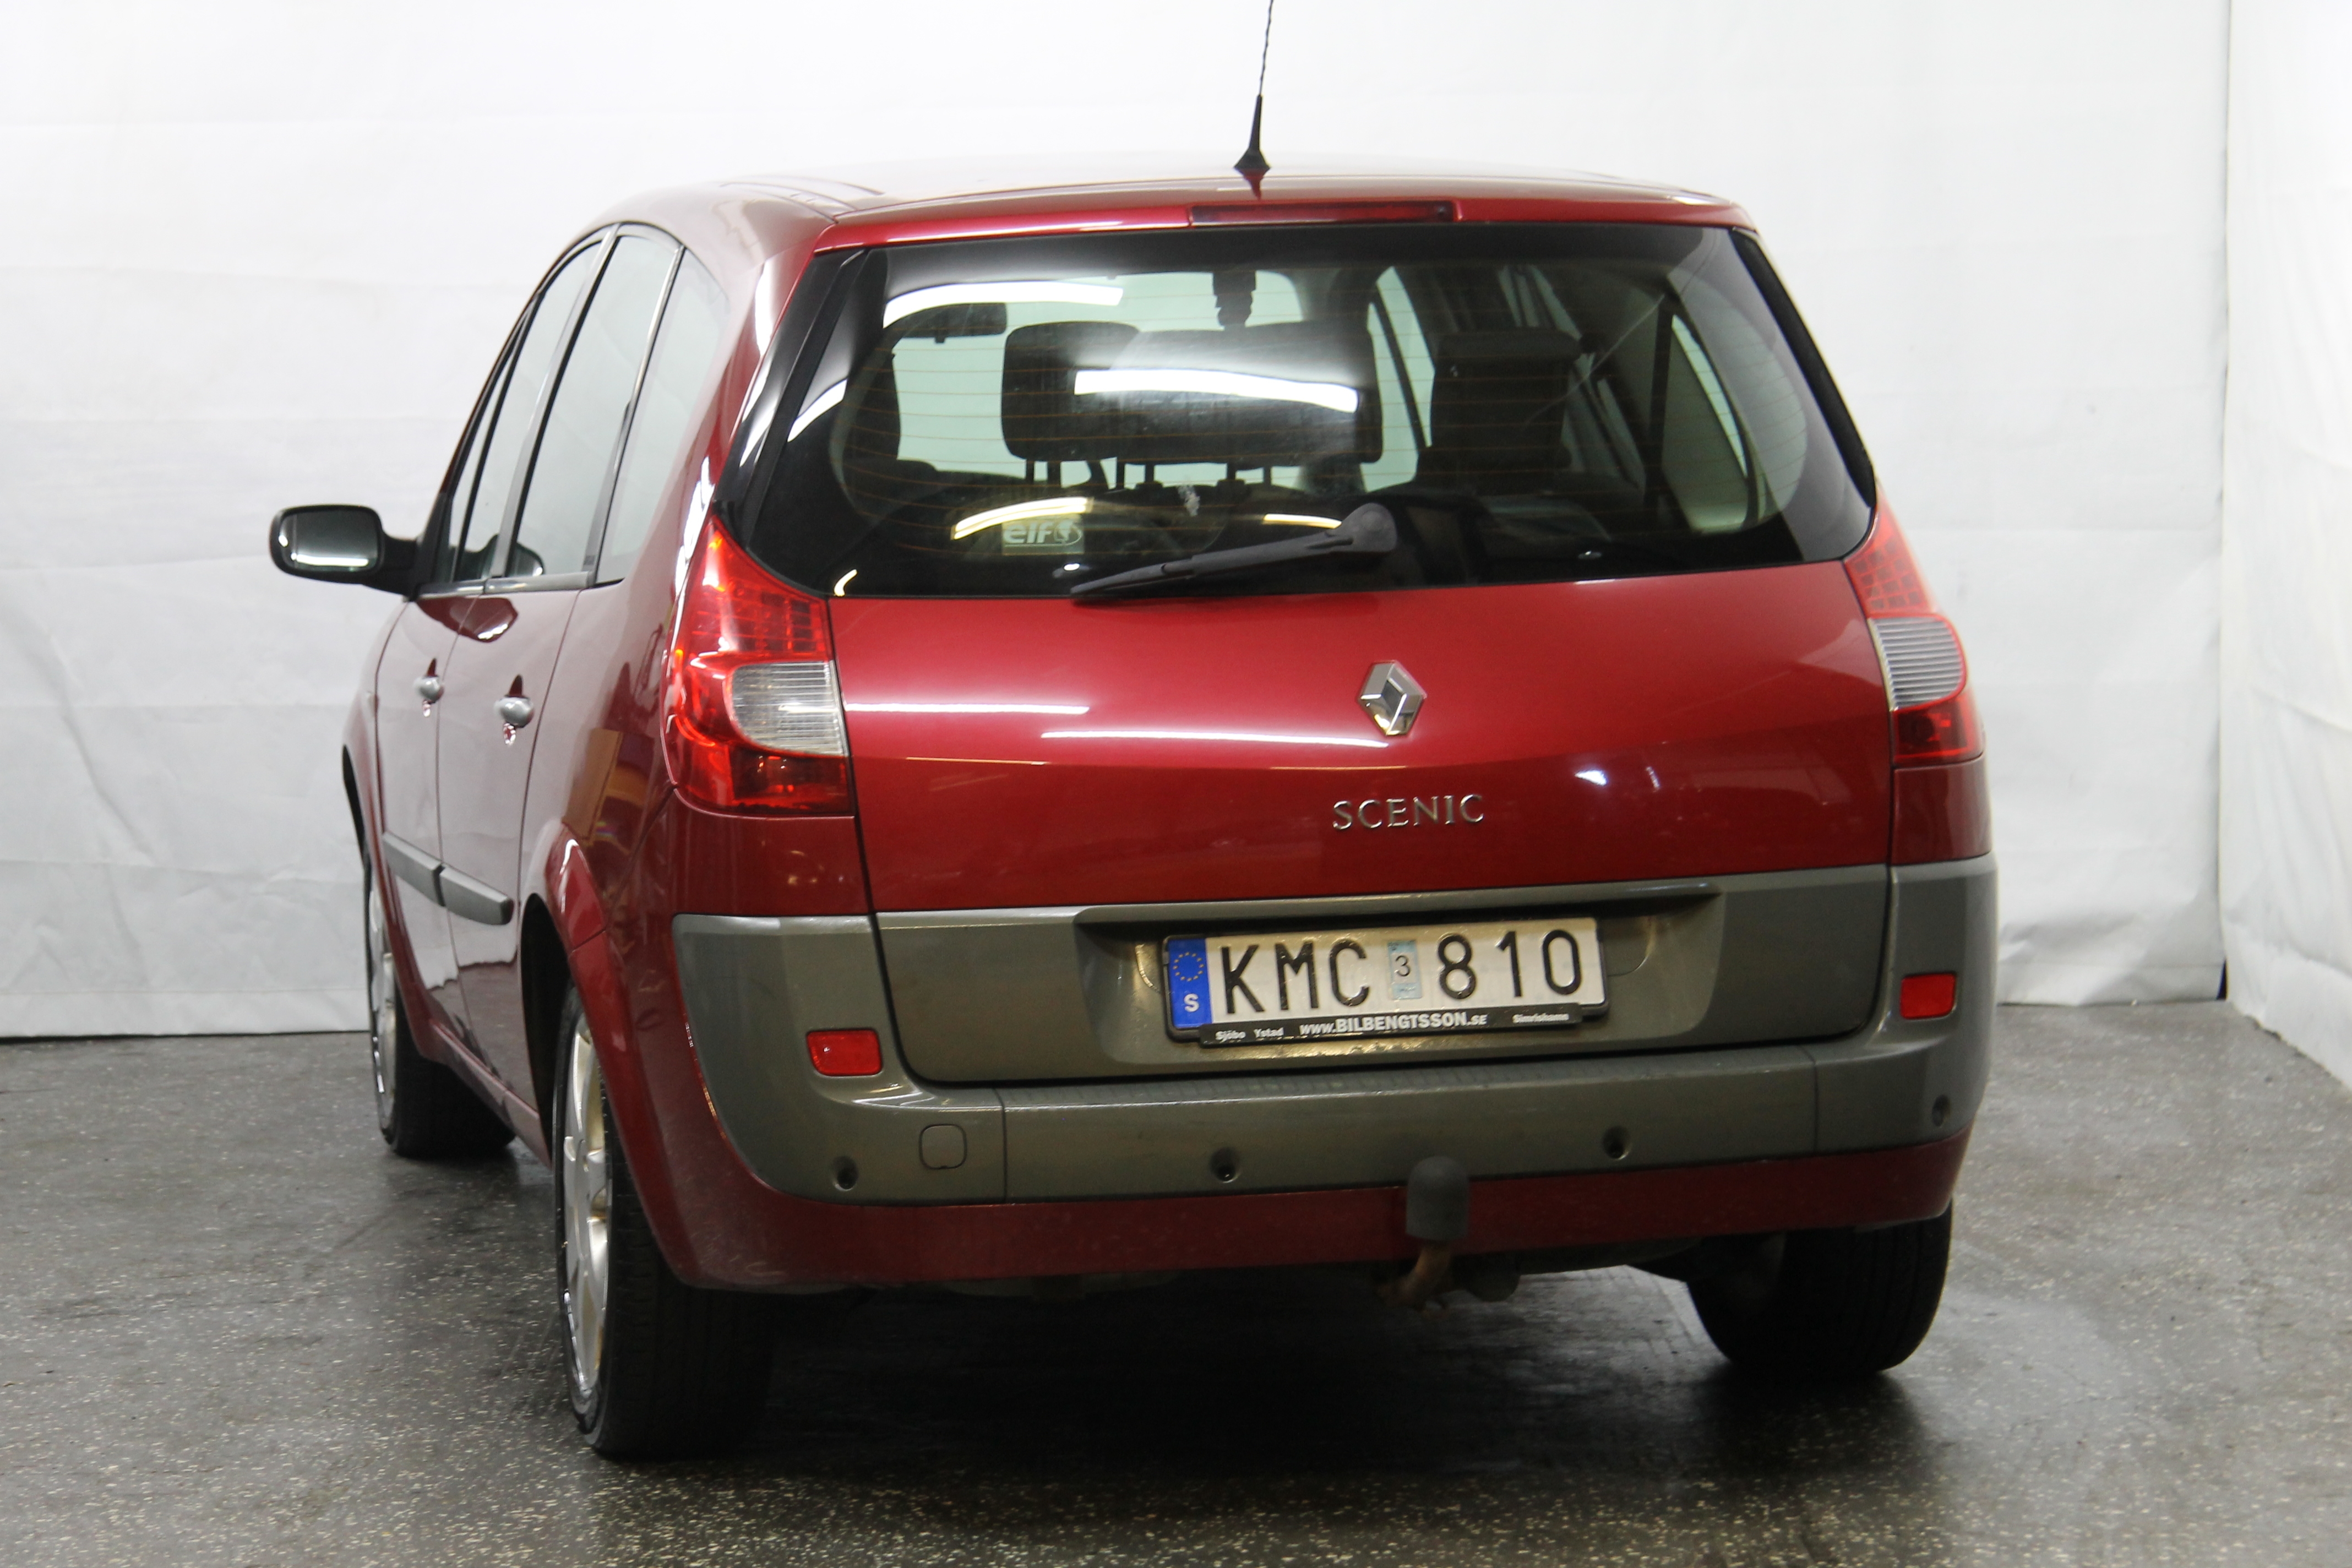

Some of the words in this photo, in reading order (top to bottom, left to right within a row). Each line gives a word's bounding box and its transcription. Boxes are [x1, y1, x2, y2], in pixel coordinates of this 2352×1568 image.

[1003, 522, 1051, 544] elf
[1332, 793, 1484, 830] SCENIC
[1221, 939, 1370, 1015] KMC
[1436, 929, 1581, 1000] 810
[1395, 955, 1411, 977] 3
[1184, 994, 1200, 1013] S
[1253, 1027, 1284, 1038] Ystad
